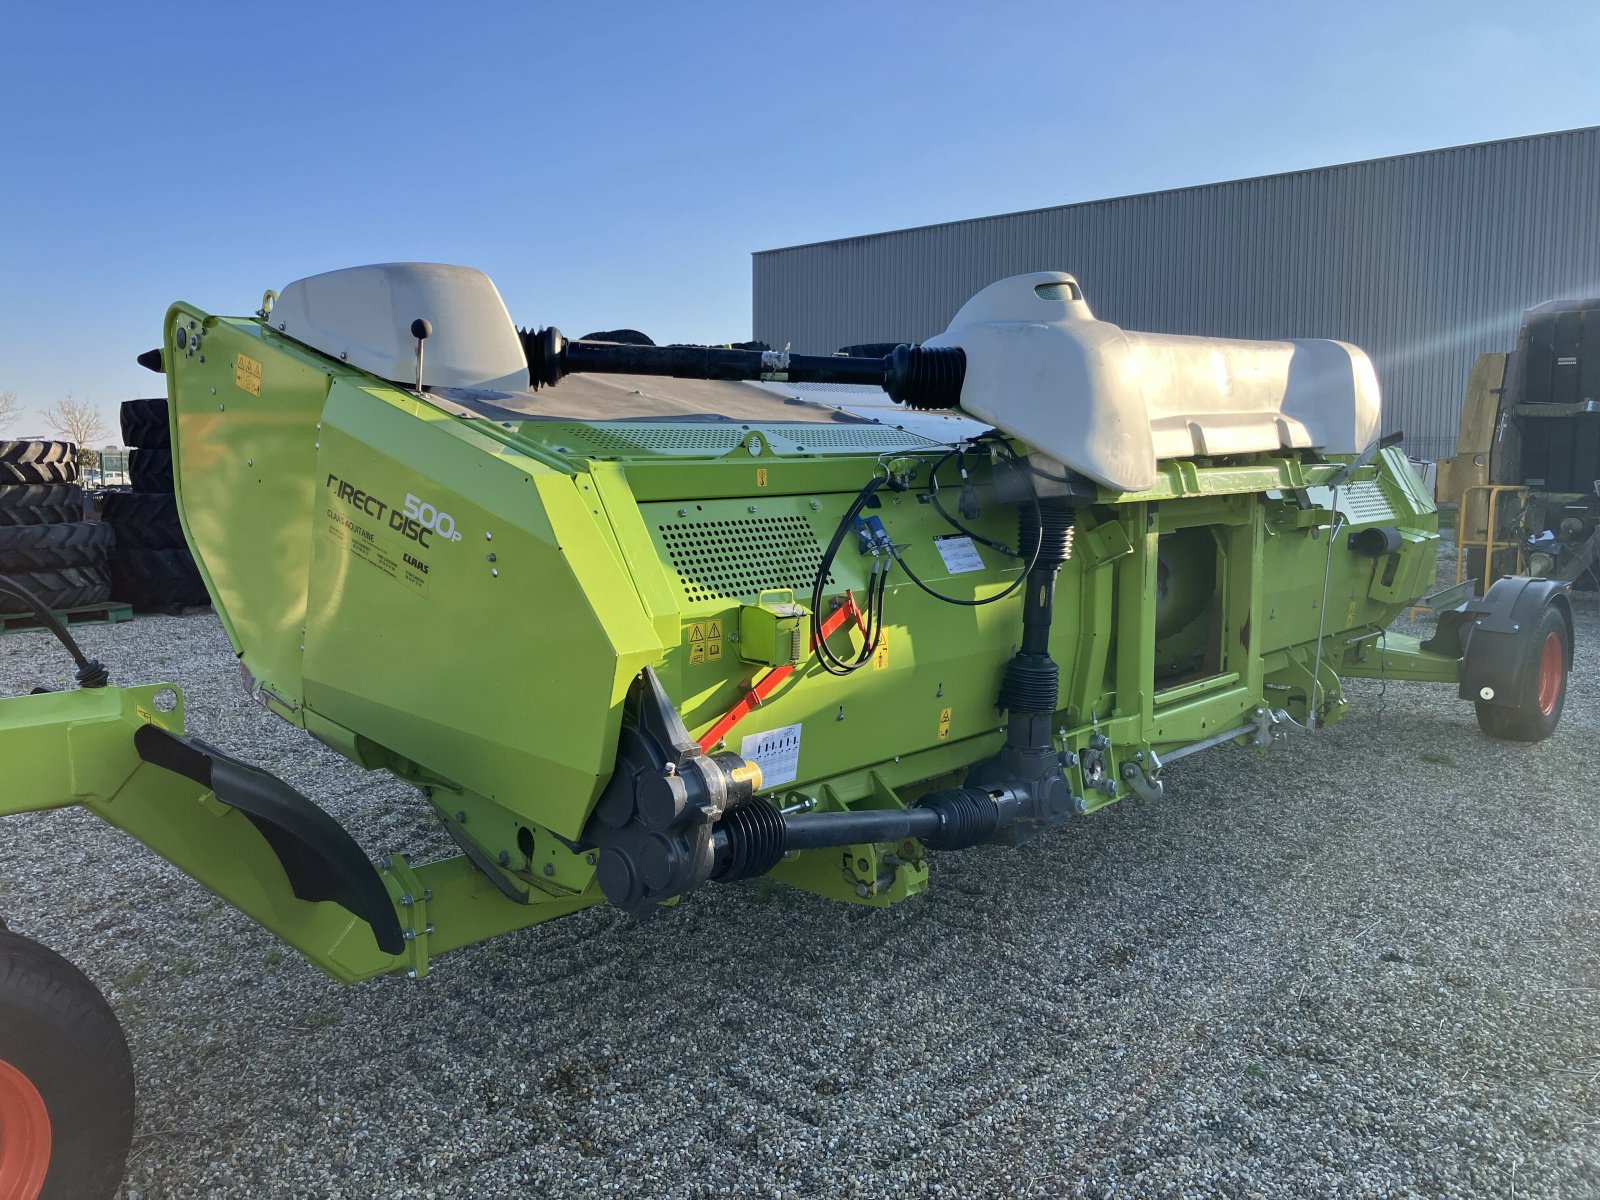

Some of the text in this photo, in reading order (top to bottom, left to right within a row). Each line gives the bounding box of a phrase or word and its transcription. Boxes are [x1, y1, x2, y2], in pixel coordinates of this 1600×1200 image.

[345, 519, 375, 543] AQUITAINE
[389, 509, 433, 549] DISC
[403, 553, 430, 575] CLAAS
